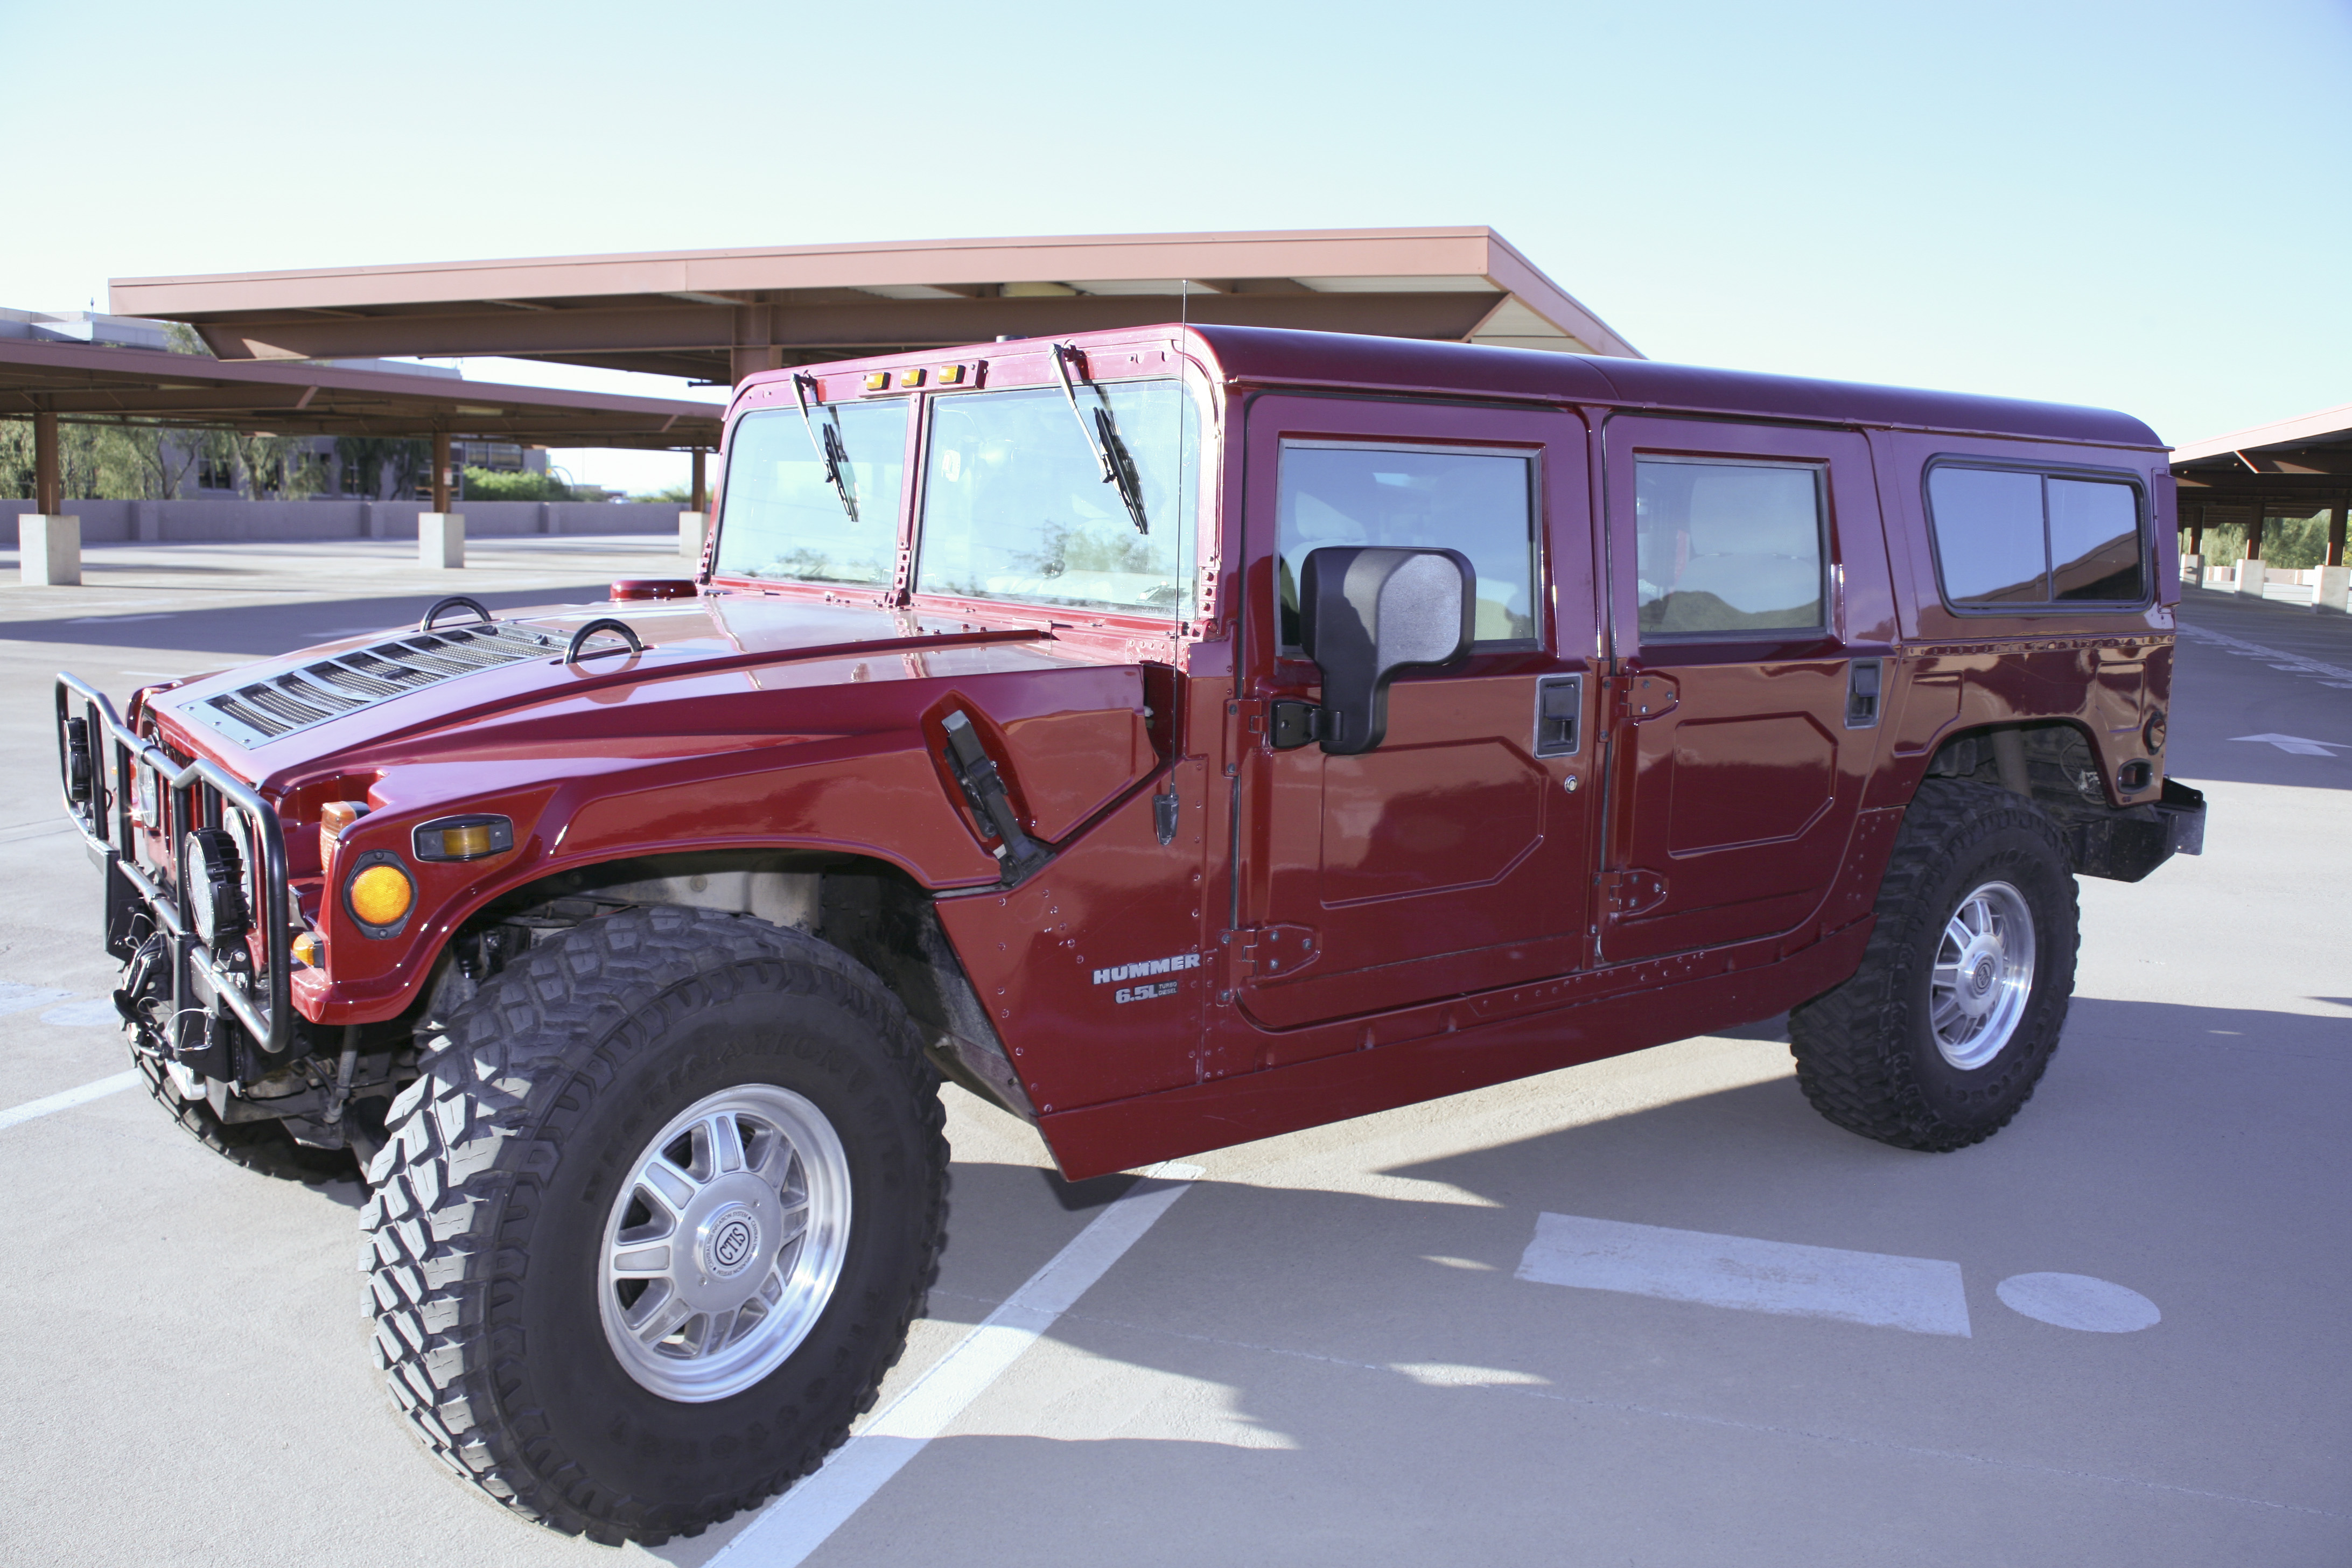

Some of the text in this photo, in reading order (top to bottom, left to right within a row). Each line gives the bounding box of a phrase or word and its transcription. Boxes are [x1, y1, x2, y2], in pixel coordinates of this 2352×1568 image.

[1093, 953, 1201, 985] HUMMER
[1115, 984, 1158, 1004] 6.5L
[719, 1227, 745, 1260] CTIS
